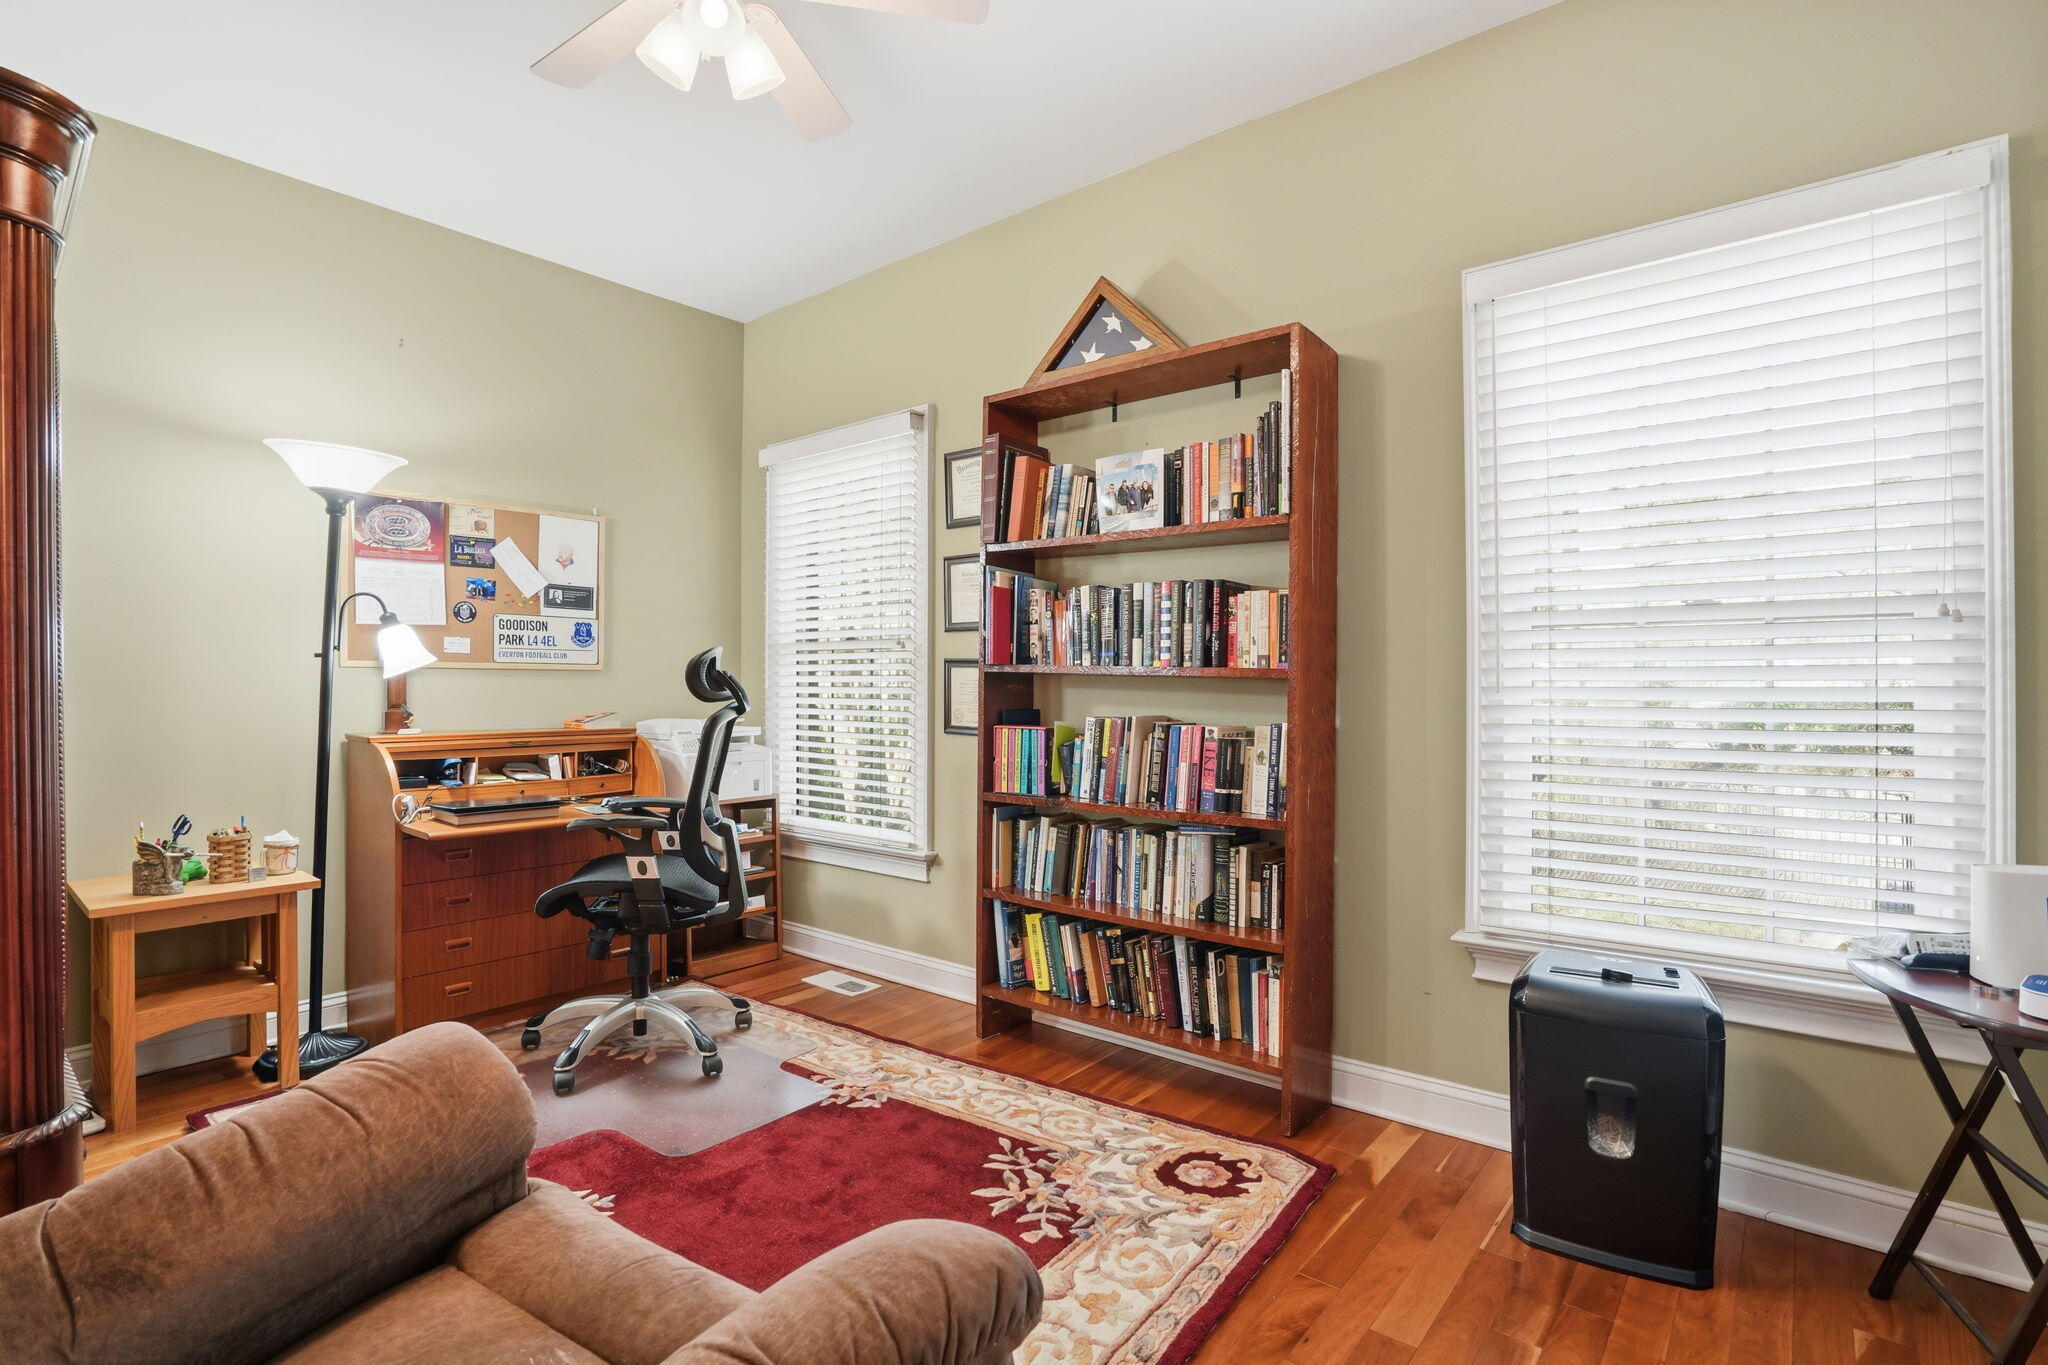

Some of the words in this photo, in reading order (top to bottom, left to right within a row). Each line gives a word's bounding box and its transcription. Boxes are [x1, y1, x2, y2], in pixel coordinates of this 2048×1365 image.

[498, 619, 548, 632] GOODISON
[499, 633, 525, 646] PARK
[527, 635, 538, 646] L4
[540, 635, 557, 647] 4EL
[525, 652, 552, 660] FOOTBALL
[553, 652, 568, 660] CLUB
[1203, 748, 1216, 777] IKE
